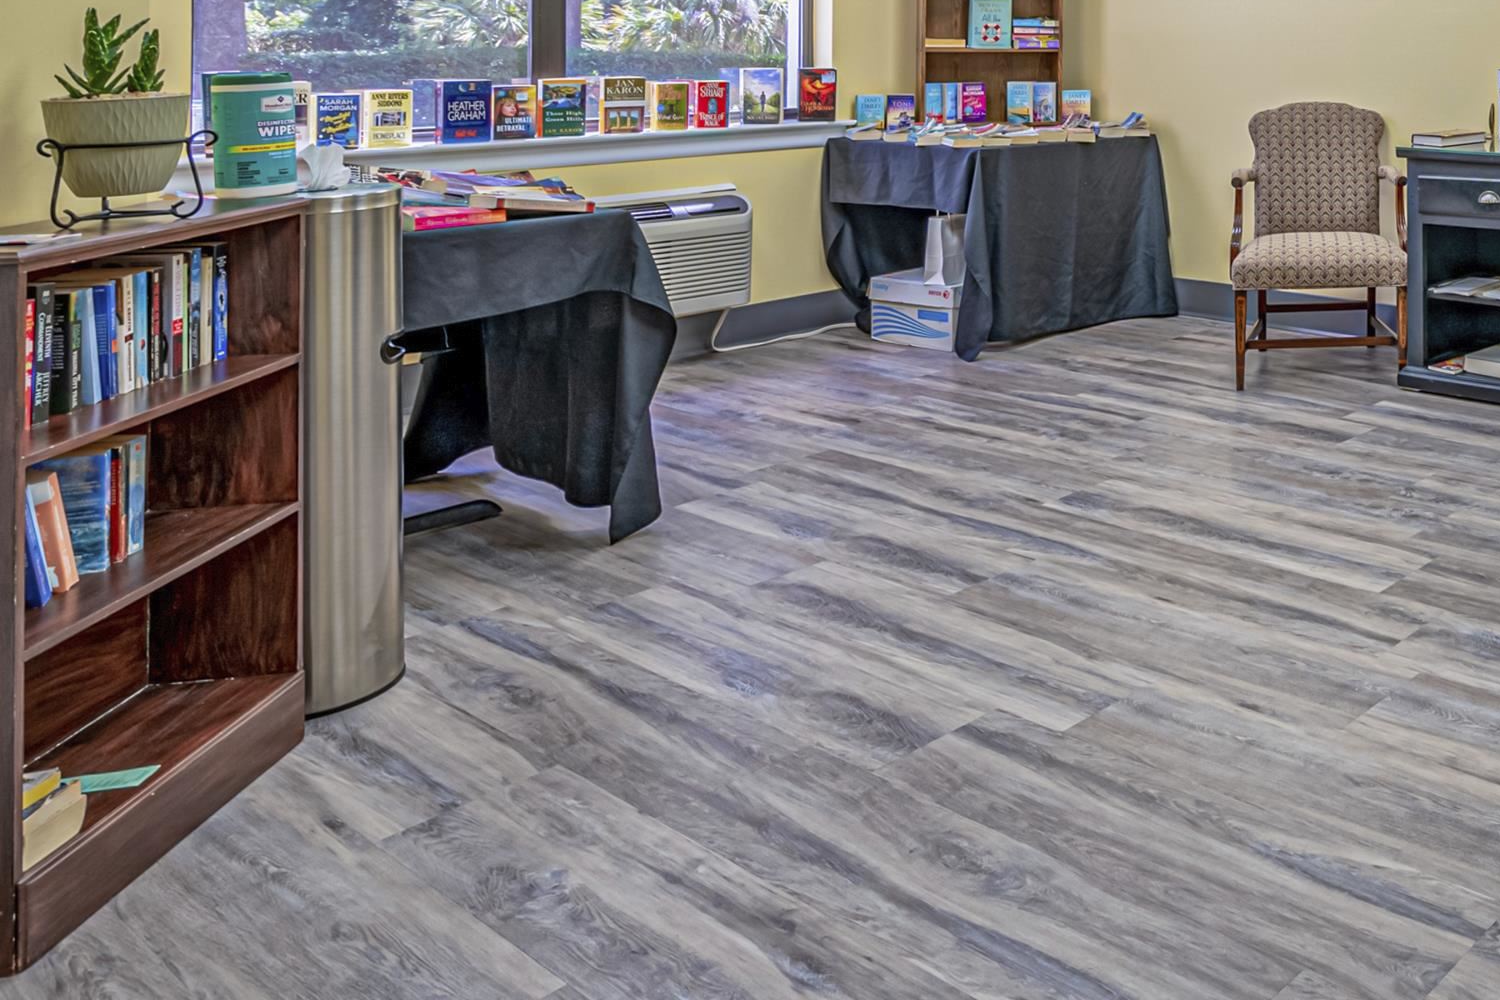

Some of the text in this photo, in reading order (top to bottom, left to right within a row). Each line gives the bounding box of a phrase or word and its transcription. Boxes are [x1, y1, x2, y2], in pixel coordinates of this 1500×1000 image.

[615, 79, 635, 87] JAN
[606, 86, 644, 94] KARON
[448, 100, 486, 111] HEATHER
[448, 110, 486, 121] GRAHAM
[257, 125, 296, 137] WIPES
[496, 124, 526, 132] BETRAYAL
